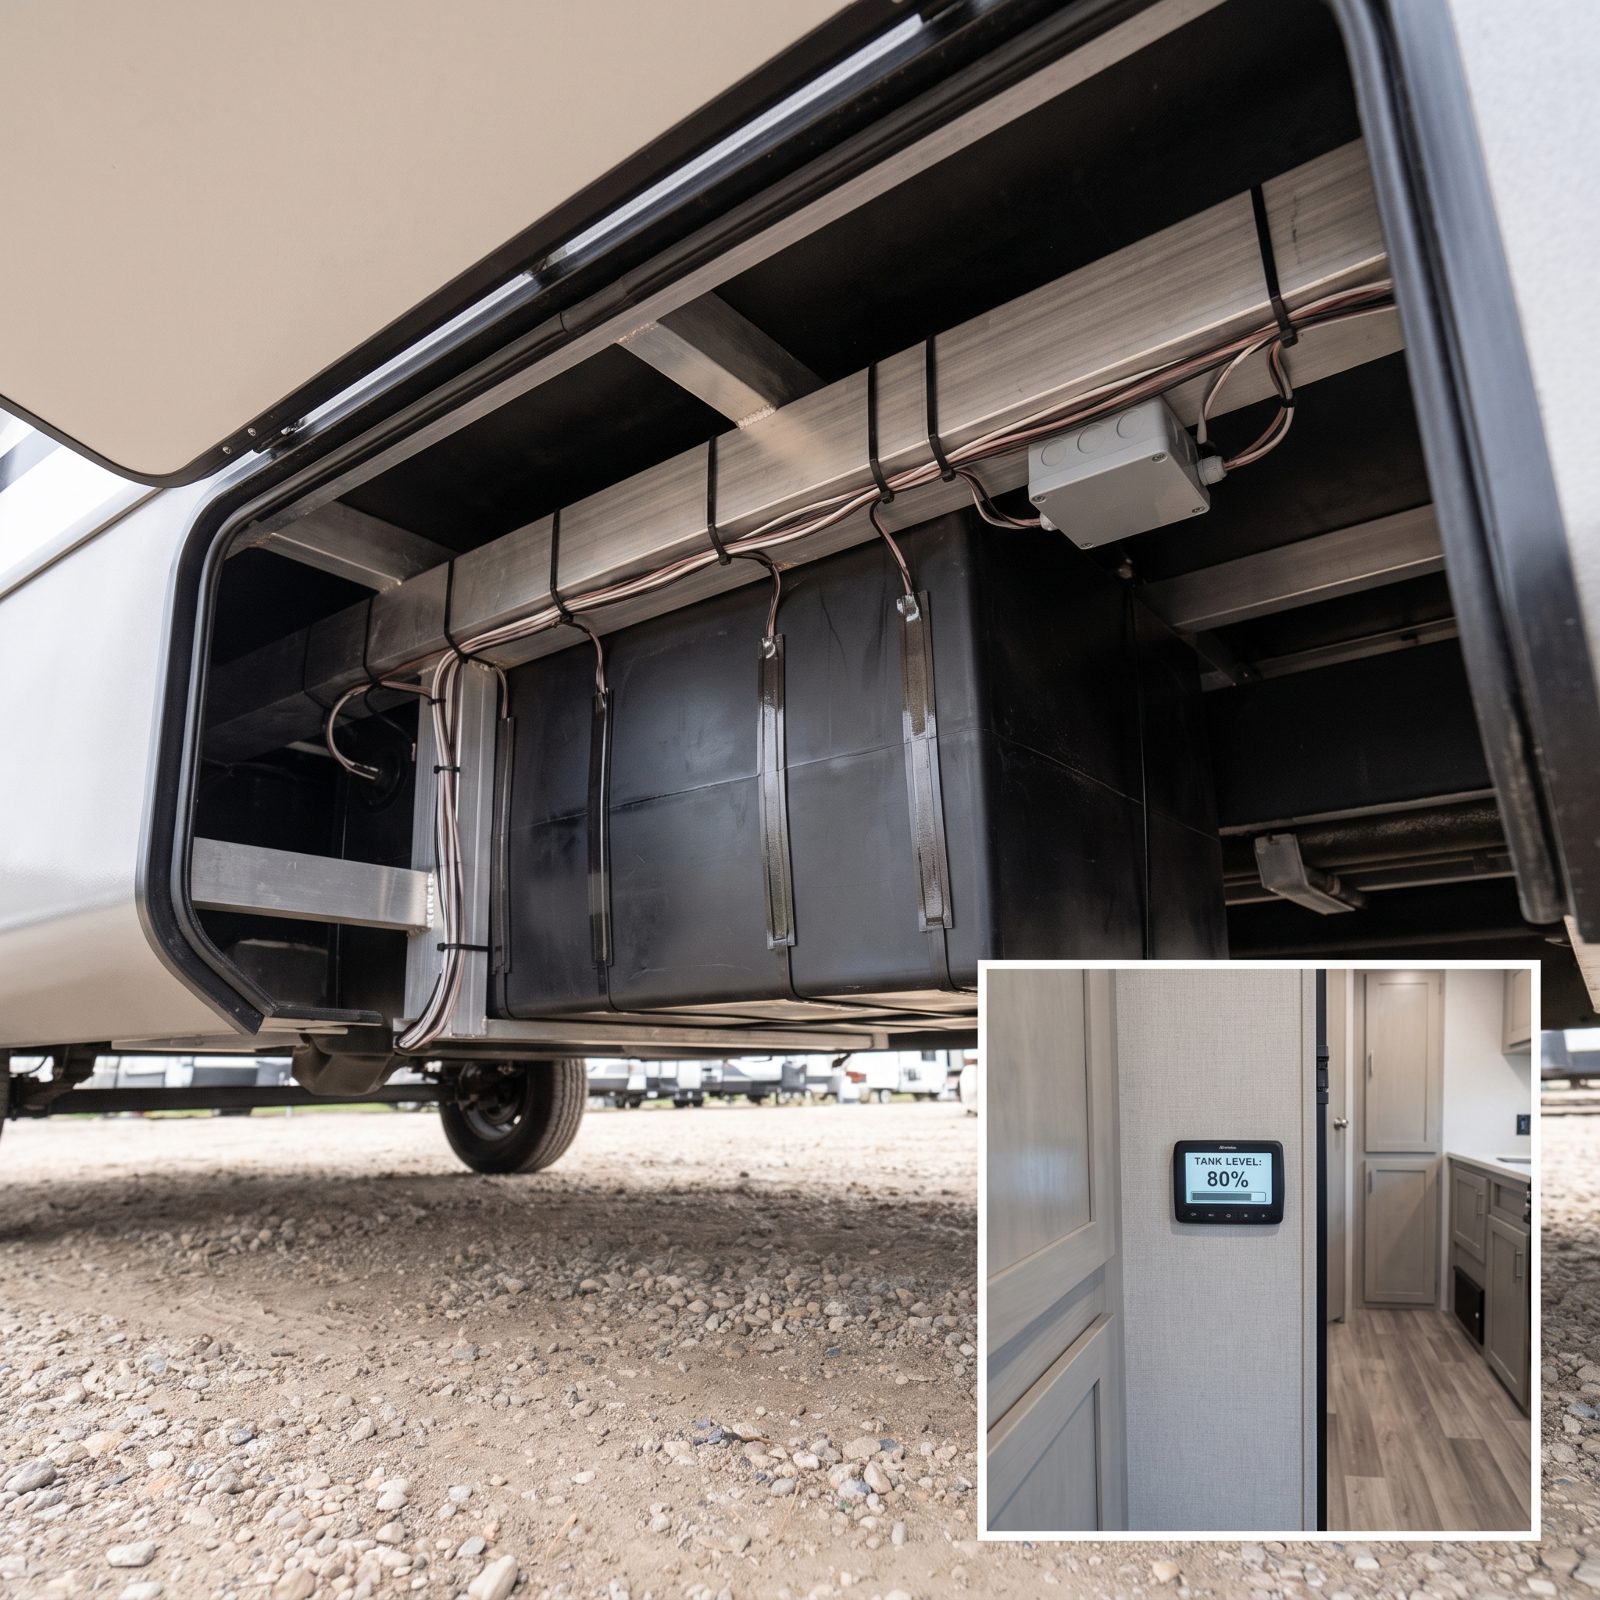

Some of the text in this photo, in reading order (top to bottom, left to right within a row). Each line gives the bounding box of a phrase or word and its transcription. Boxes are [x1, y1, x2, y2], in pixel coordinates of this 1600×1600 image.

[1195, 1157, 1262, 1166] TANK LEVEL:
[1207, 1170, 1249, 1188] 80%
